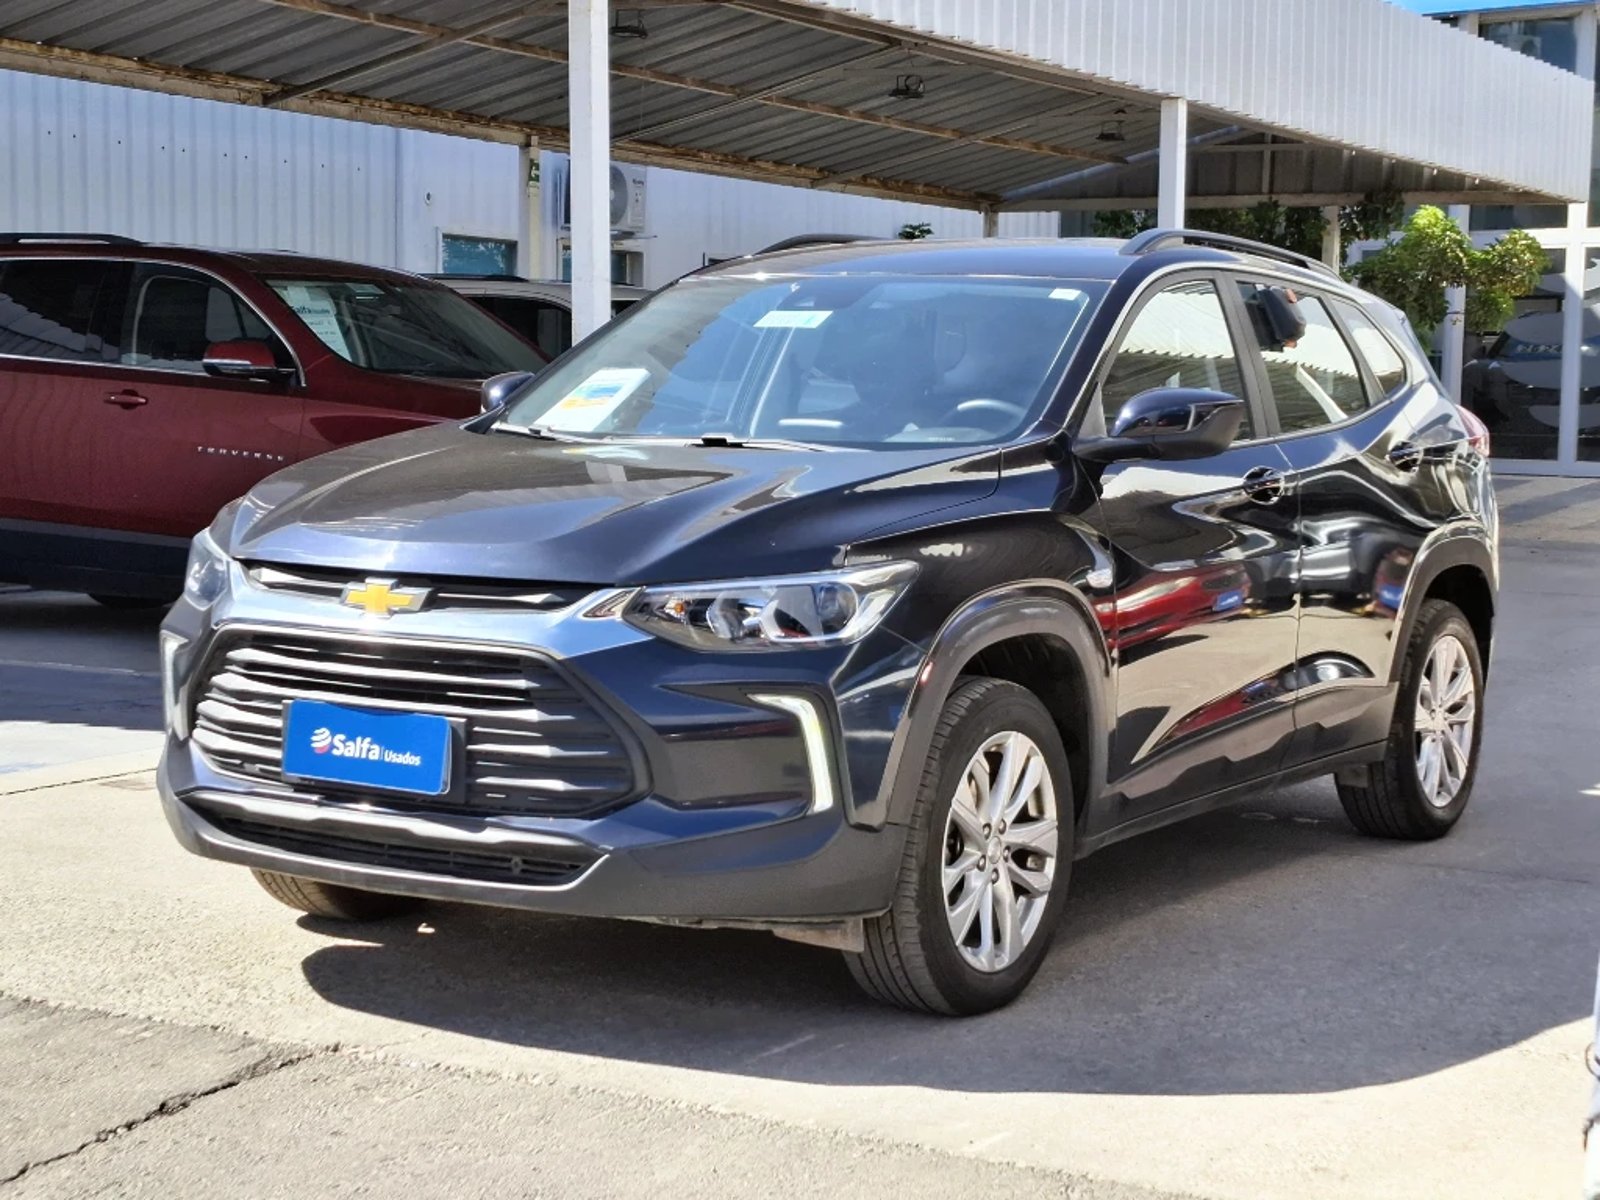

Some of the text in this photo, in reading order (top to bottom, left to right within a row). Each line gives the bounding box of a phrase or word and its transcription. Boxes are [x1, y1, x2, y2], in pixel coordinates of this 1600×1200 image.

[197, 446, 284, 461] TRAVERSE
[331, 733, 421, 767] Salfa Usados
